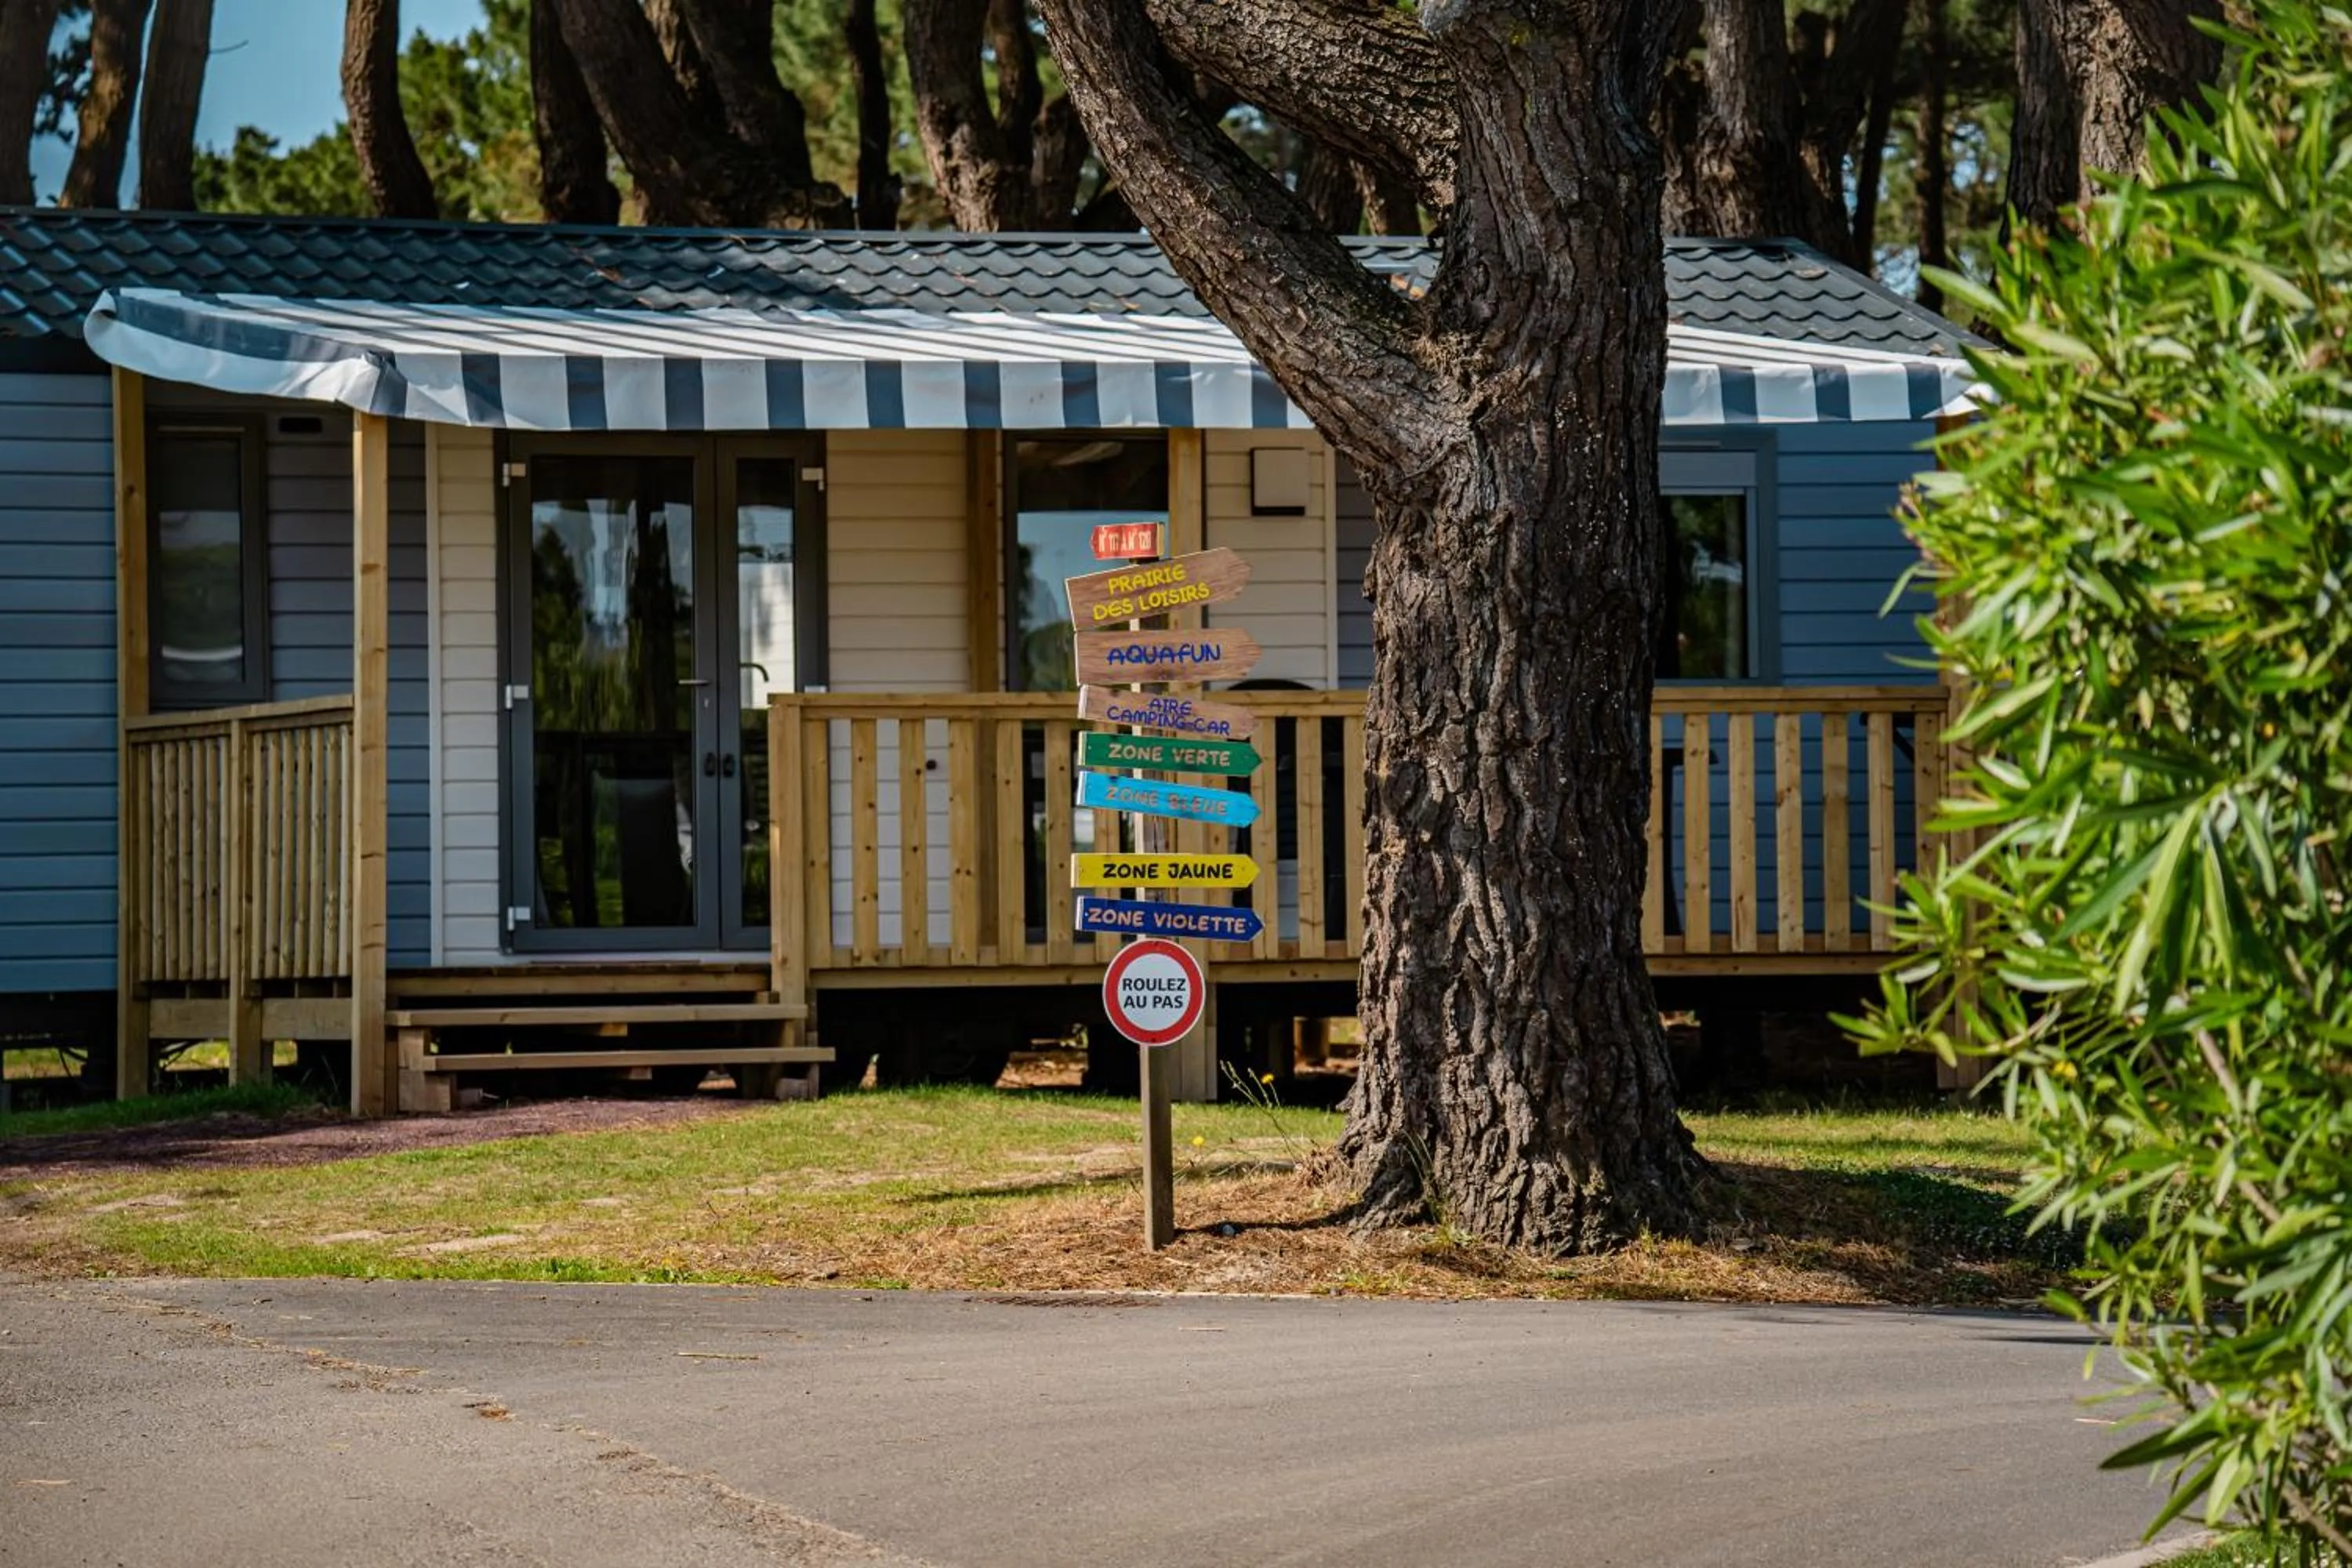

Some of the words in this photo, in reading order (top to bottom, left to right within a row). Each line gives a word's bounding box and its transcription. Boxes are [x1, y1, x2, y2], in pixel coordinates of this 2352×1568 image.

[1108, 564, 1186, 594] PRAIRIE
[1092, 597, 1133, 621] DES
[1138, 582, 1210, 612] LOISIRS
[1106, 644, 1220, 665] AQUAFUN
[1148, 698, 1192, 716] AIRE
[1106, 706, 1229, 735] CAMPING-CAR
[1108, 742, 1163, 762] ZONE
[1172, 747, 1230, 766] VERTE
[1105, 786, 1160, 808] ZONE
[1167, 793, 1228, 815] BLEUE
[1102, 863, 1159, 879] ZONE
[1167, 863, 1233, 879] JAUNE
[1087, 907, 1145, 927] ZONE
[1152, 912, 1246, 934] VIOLETTE
[1122, 978, 1186, 993] ROULEZ
[1123, 995, 1147, 1009] AU
[1152, 995, 1184, 1009] PAS
